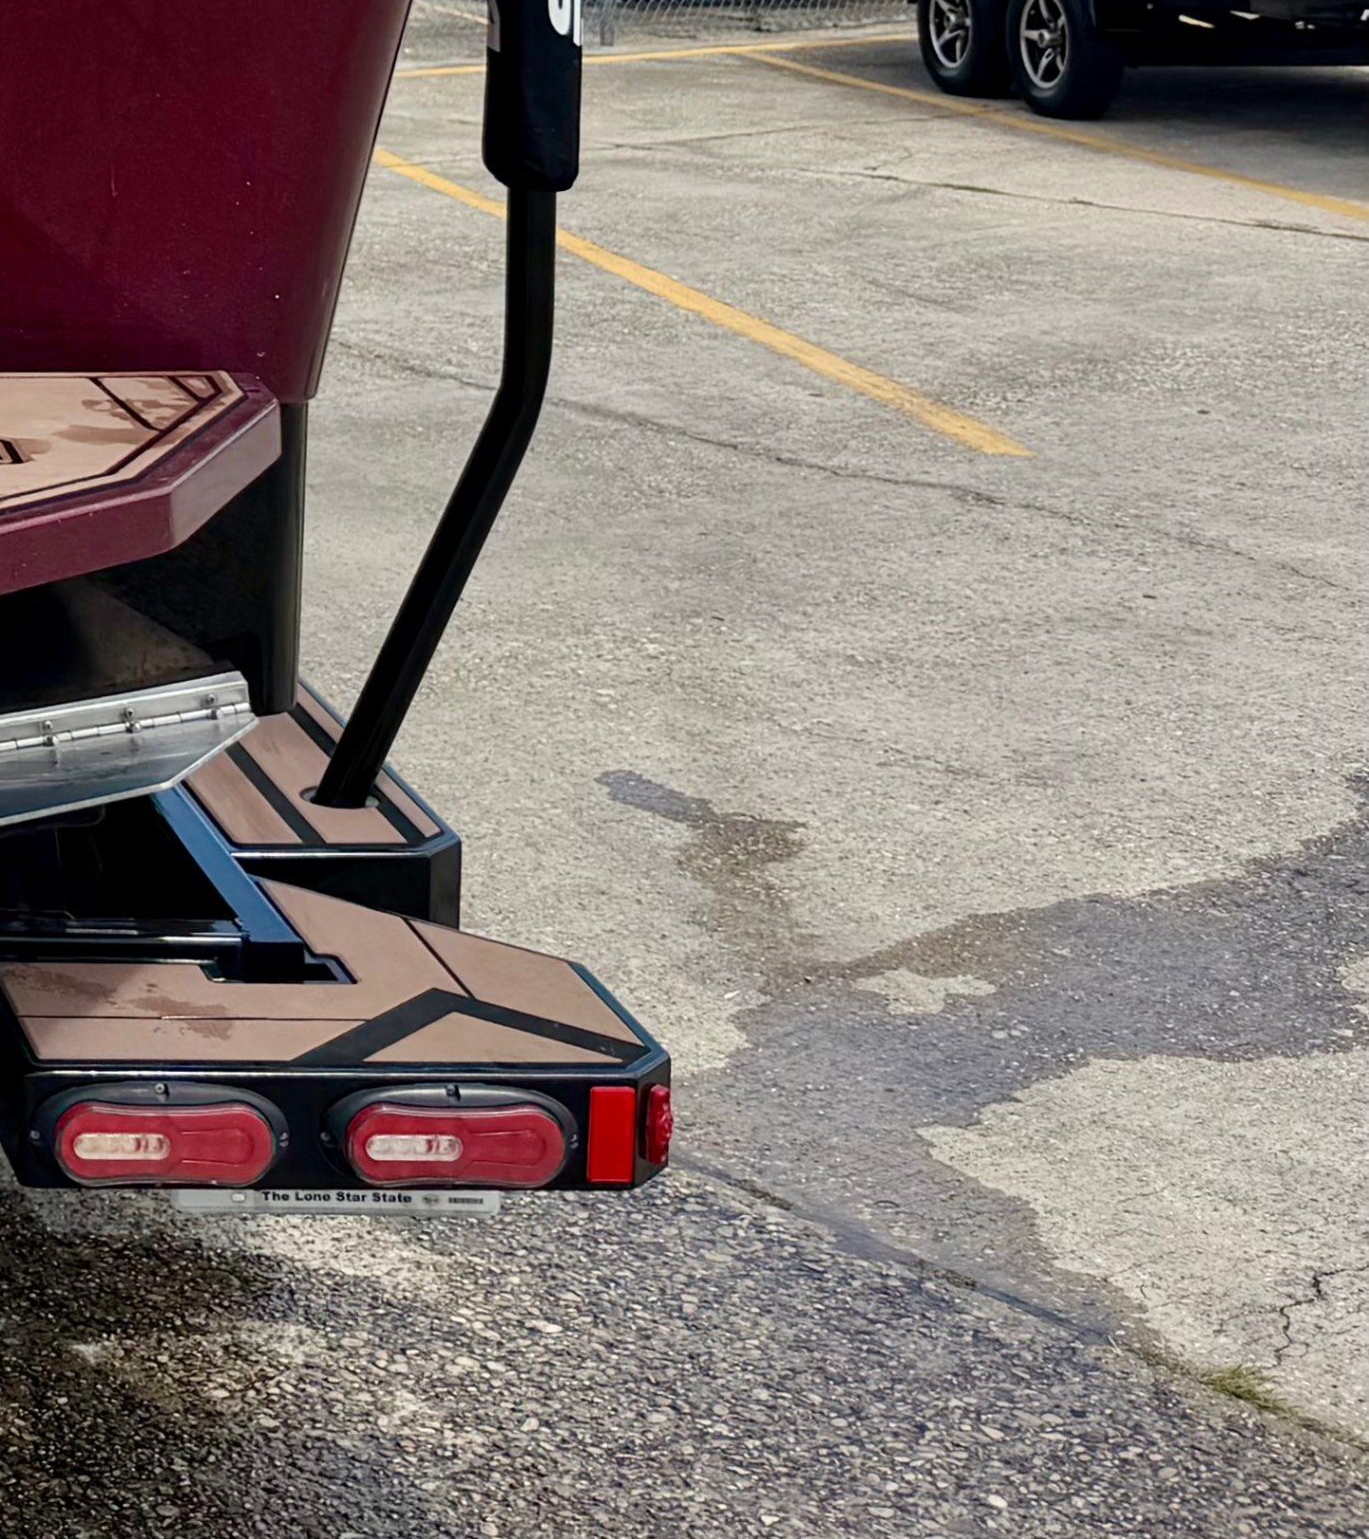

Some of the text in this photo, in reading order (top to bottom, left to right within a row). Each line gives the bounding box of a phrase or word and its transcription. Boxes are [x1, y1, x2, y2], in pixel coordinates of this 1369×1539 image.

[262, 1191, 290, 1203] The
[294, 1191, 331, 1203] Lone
[335, 1191, 366, 1203] Star
[371, 1192, 412, 1204] State
